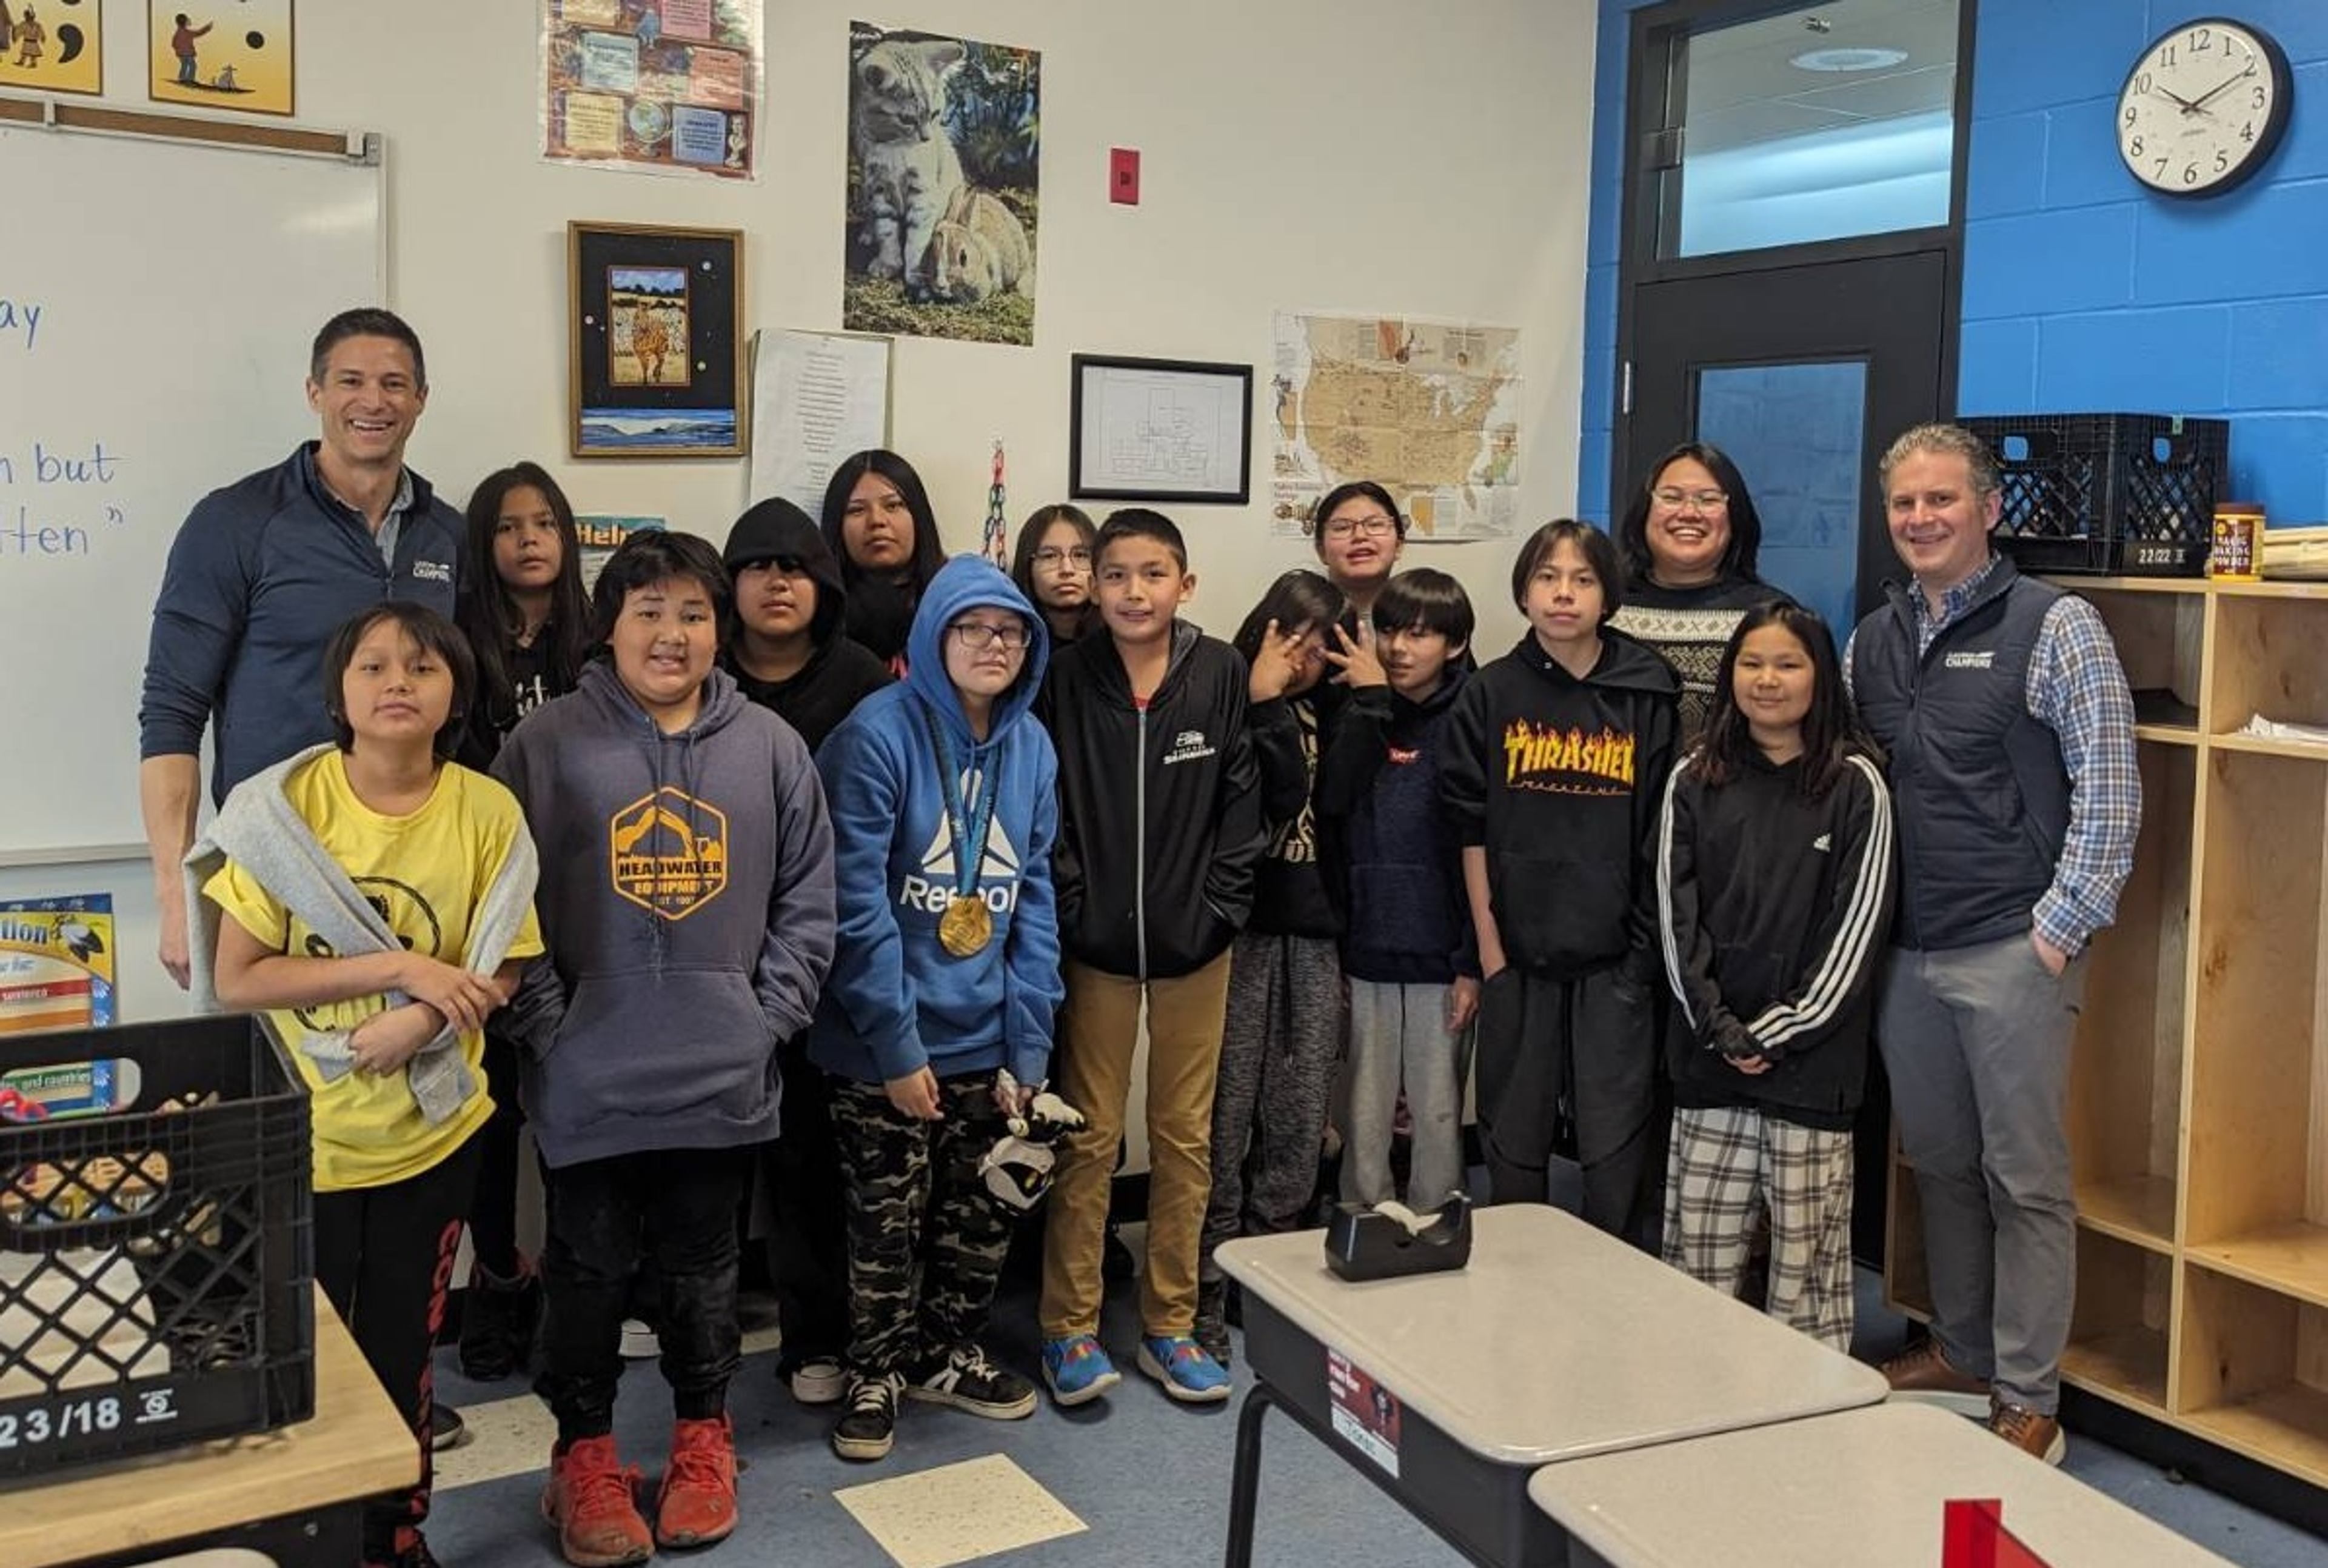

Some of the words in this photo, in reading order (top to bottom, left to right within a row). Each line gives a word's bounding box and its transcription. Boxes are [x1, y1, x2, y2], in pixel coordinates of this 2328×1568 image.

[2189, 28, 2212, 53] 12
[2222, 36, 2233, 57] 1
[2159, 44, 2177, 67] 11
[2243, 55, 2257, 78] 2
[2132, 73, 2152, 95] 10
[2252, 87, 2266, 110] 3
[2125, 107, 2137, 128] 9
[2239, 120, 2255, 142] 4
[2130, 136, 2144, 158] 8
[2154, 157, 2169, 181] 7
[2213, 149, 2229, 173] 5
[2184, 161, 2199, 185] 6
[36, 444, 130, 484] but
[619, 861, 721, 876] HEADWATER
[634, 880, 714, 894] EQIPMET
[899, 875, 1020, 913] Reo
